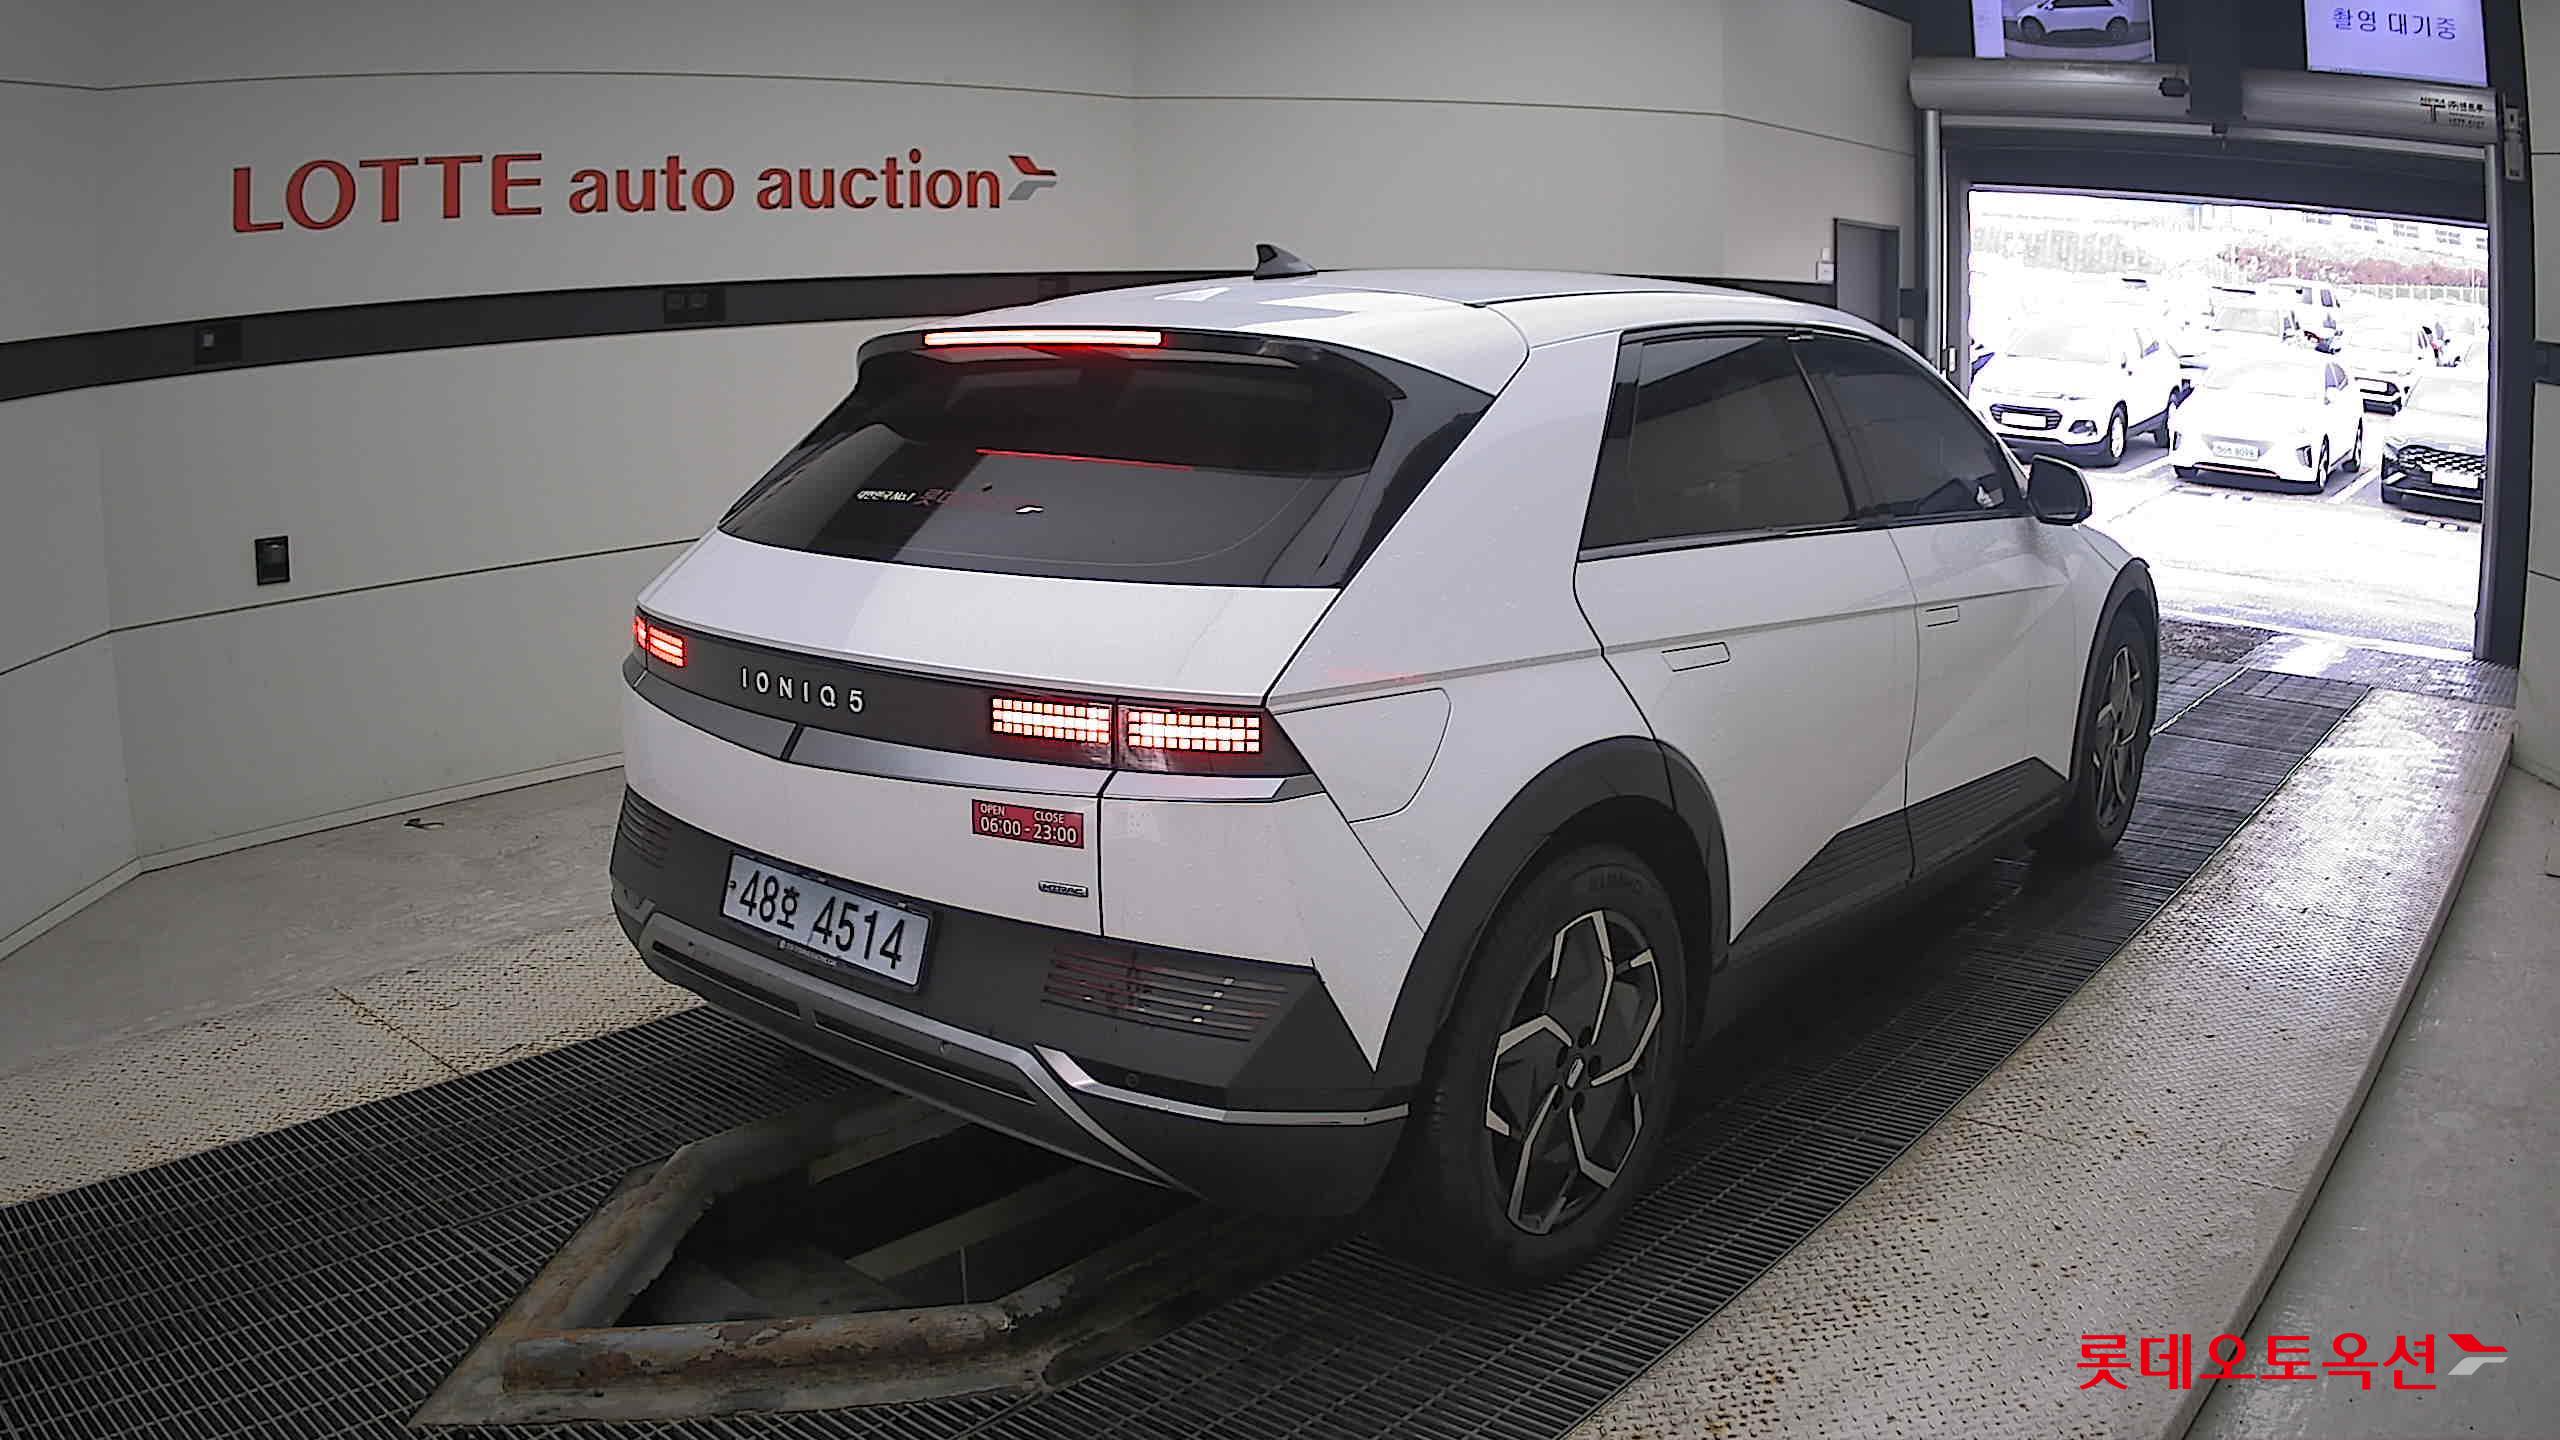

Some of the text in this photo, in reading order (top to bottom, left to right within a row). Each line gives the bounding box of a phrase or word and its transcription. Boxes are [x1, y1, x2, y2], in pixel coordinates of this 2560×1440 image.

[2333, 7, 2457, 40] 촬영 대기중
[233, 148, 1001, 233] LOTTE auto auction
[742, 667, 863, 713] IONIQ 5
[979, 803, 1064, 824] OPEN CLOSE
[980, 816, 1021, 836] 06:00
[1033, 823, 1077, 843] 23:00
[739, 869, 800, 931] 48호
[812, 896, 906, 970] 4514
